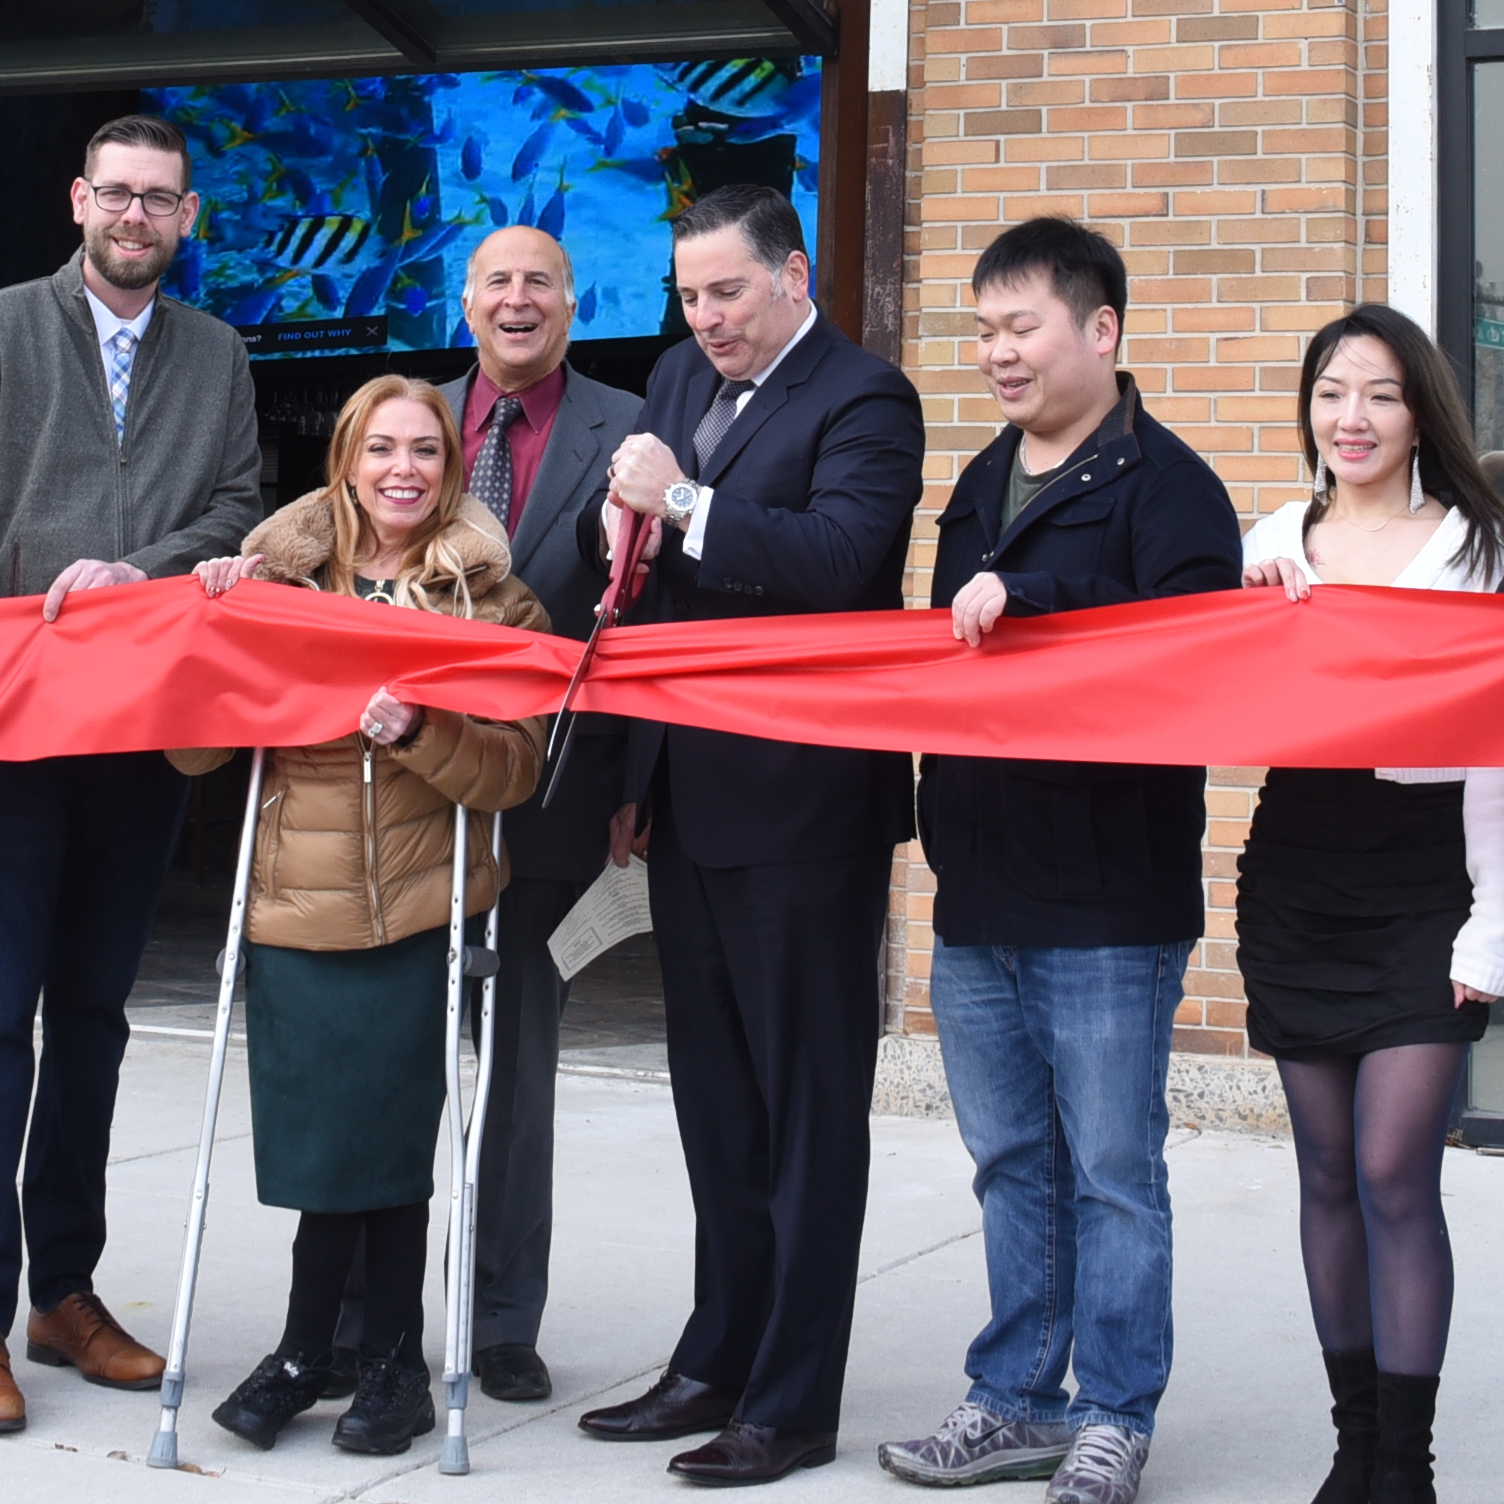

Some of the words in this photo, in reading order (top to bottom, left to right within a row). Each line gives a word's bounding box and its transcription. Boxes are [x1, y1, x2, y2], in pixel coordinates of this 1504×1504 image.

[278, 332, 302, 341] FIND
[304, 330, 325, 340] OUT
[328, 328, 351, 337] WHY
